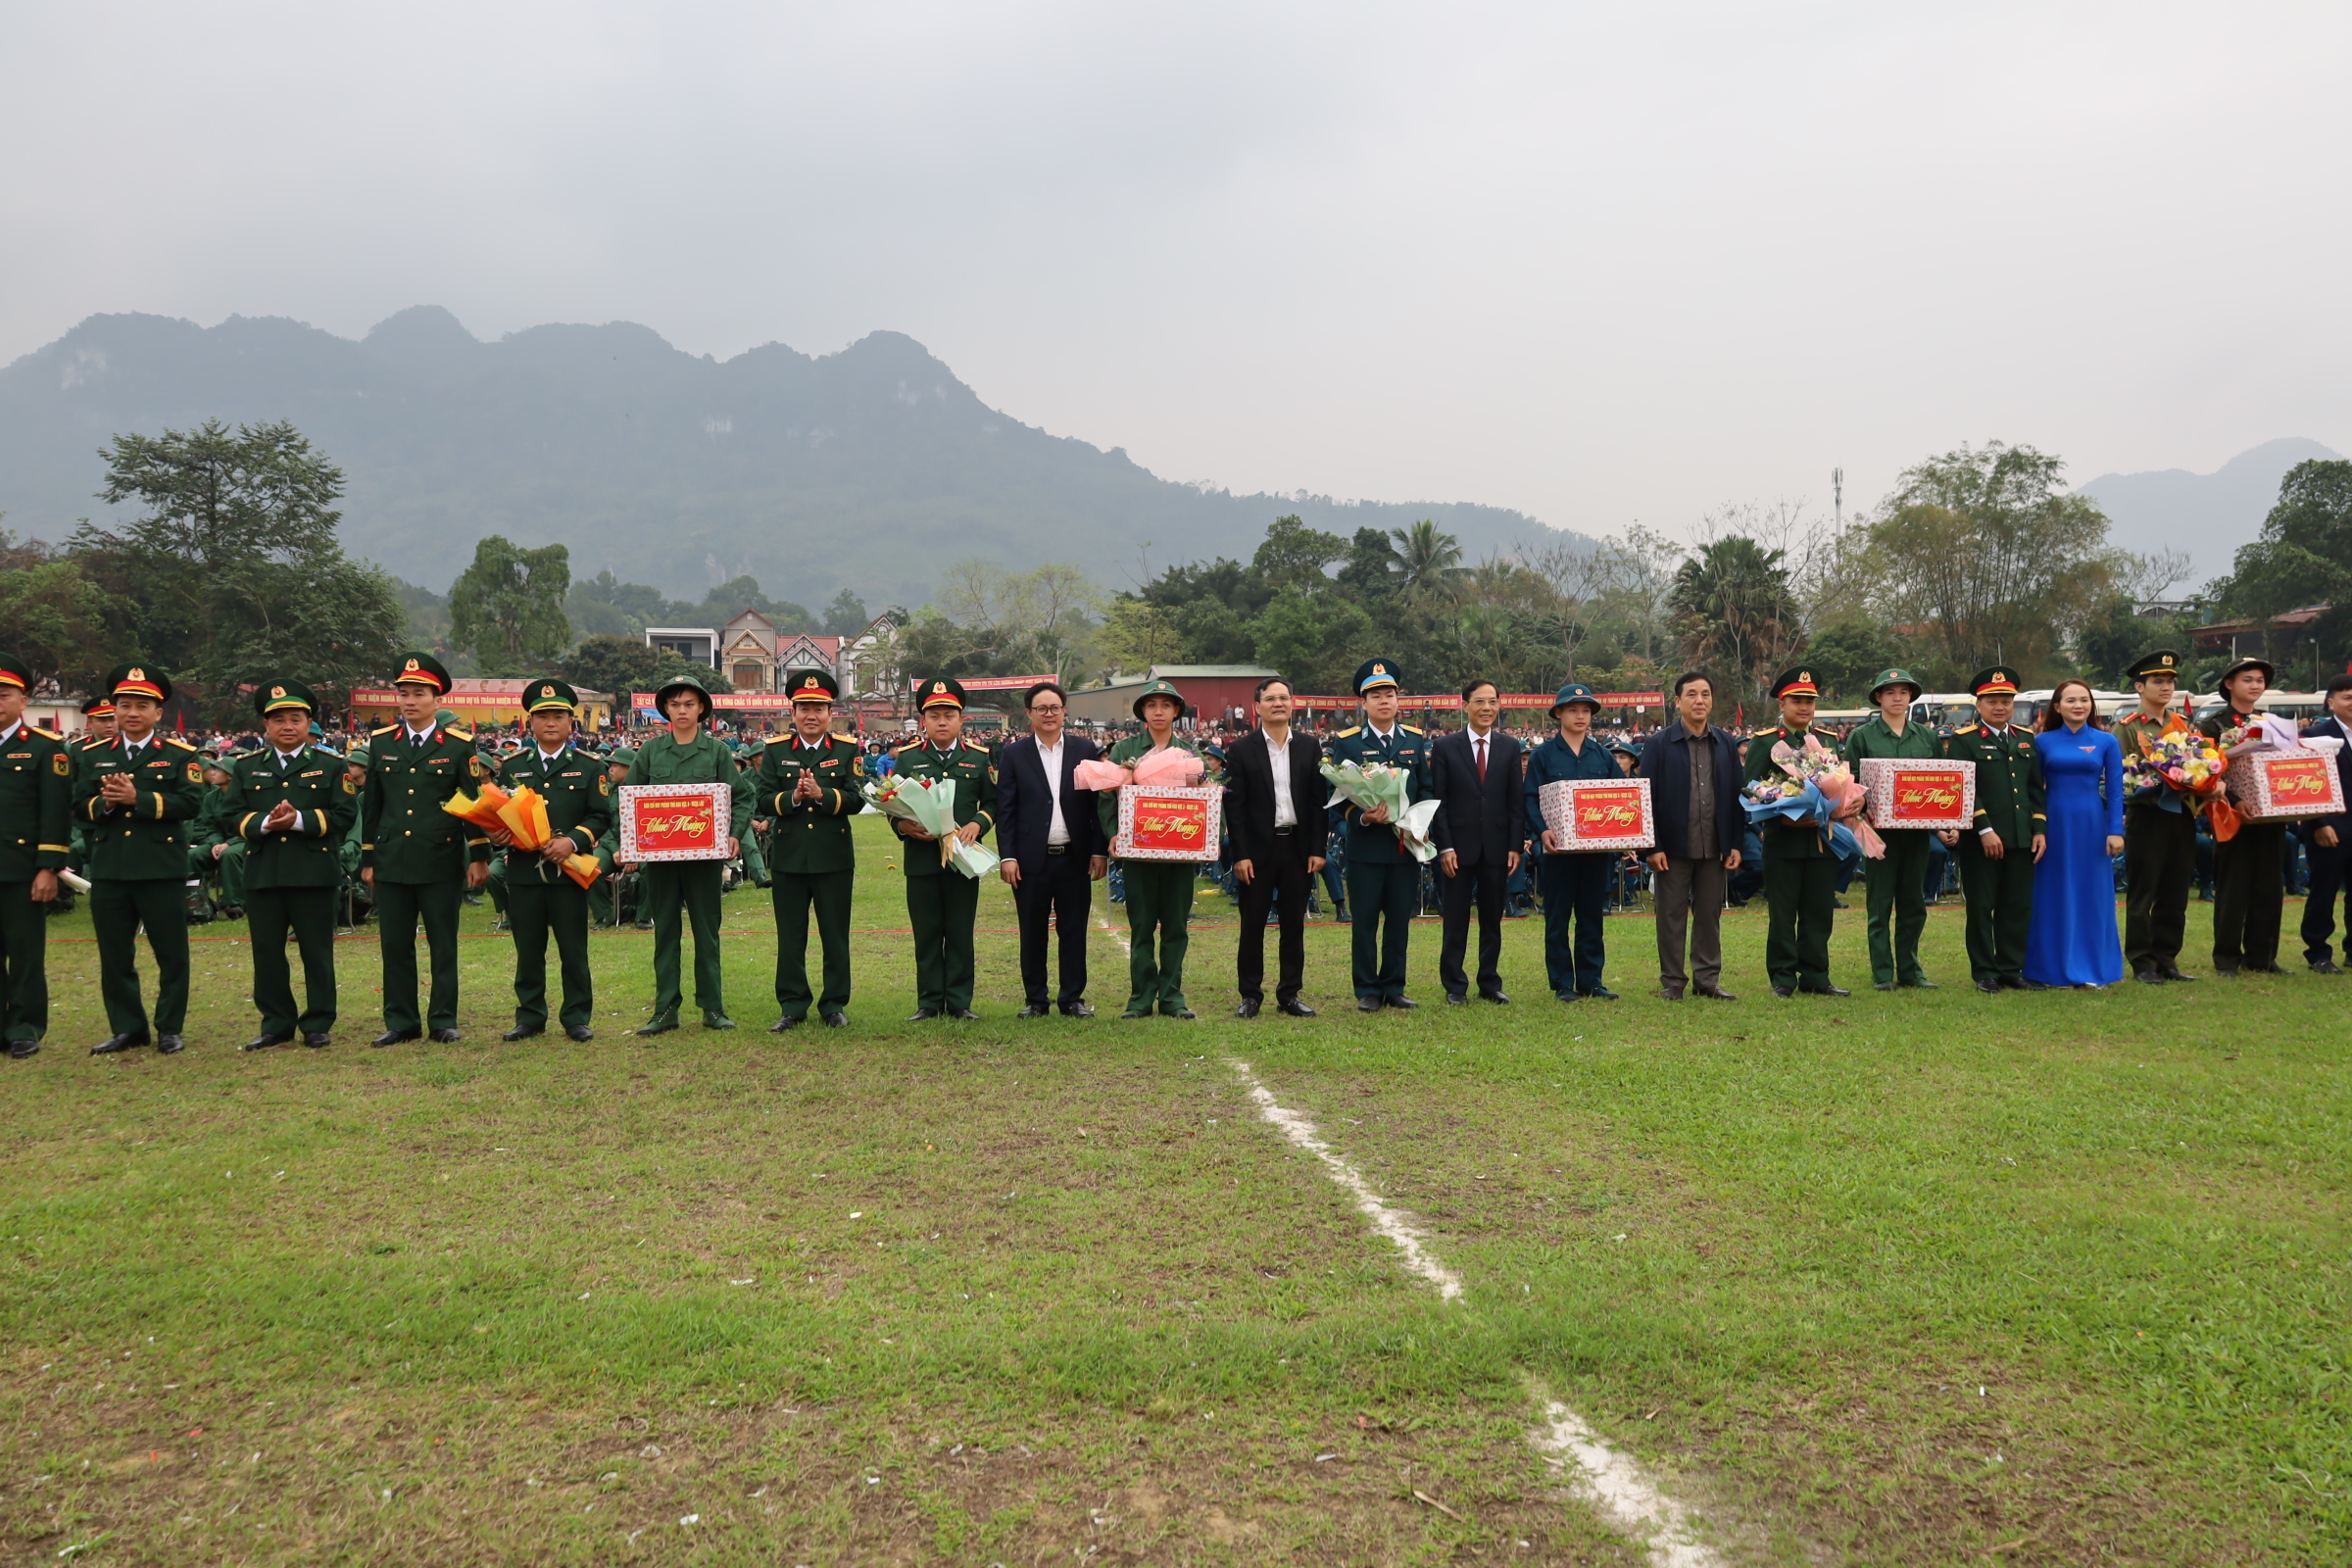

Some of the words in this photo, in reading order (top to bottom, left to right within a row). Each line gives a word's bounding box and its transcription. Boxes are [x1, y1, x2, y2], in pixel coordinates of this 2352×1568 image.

[355, 694, 367, 703] THỰC
[368, 693, 380, 703] HIỆN
[447, 695, 454, 704] LÀ
[474, 696, 480, 704] VÀ
[481, 696, 495, 704] TRÁCH
[496, 696, 511, 706] NHIỆM
[512, 695, 522, 704] CỦA
[751, 697, 763, 706] QUỐC
[764, 698, 772, 707] VIỆT
[1518, 697, 1526, 705] QUỐC
[2271, 777, 2295, 796] Chúc
[1897, 789, 1924, 808] Chúc
[1916, 788, 1959, 809] Mừng
[1578, 807, 1605, 827] Chúc
[1597, 805, 1638, 827] Mừng
[640, 817, 671, 839] Chúc
[662, 815, 710, 838] Mừng
[1138, 816, 1166, 837] Chúc
[1157, 816, 1203, 840] Mừng
